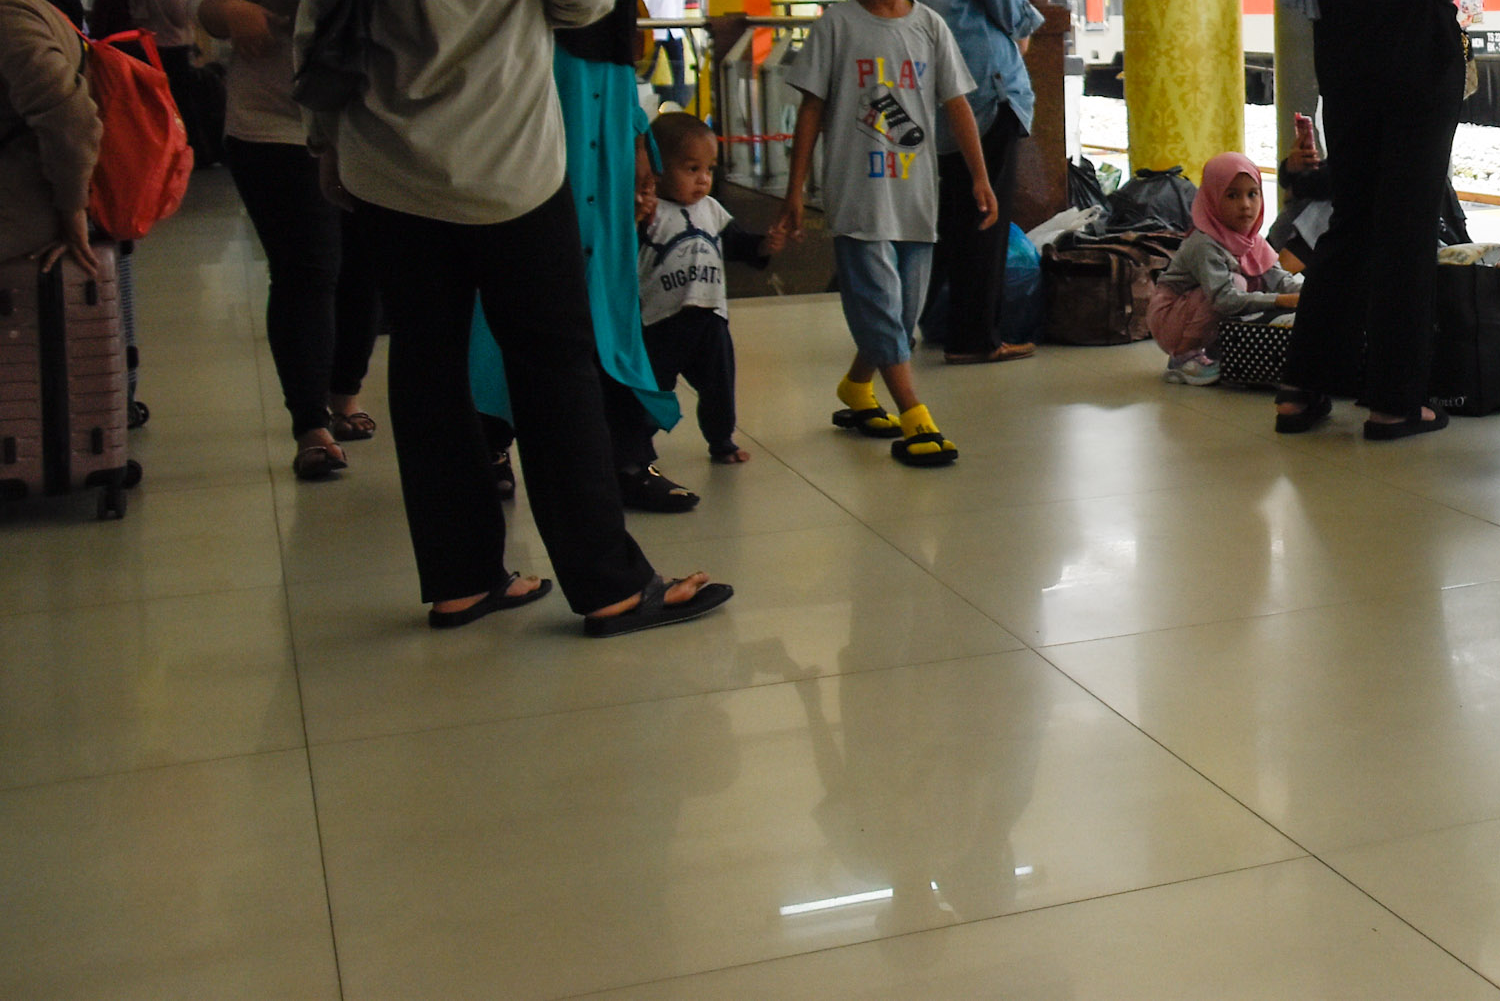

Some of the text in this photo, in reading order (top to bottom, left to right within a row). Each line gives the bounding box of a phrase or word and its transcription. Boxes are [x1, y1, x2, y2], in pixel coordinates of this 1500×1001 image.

[856, 57, 927, 90] PLAY
[869, 151, 916, 180] DAY
[661, 269, 687, 291] BIG
